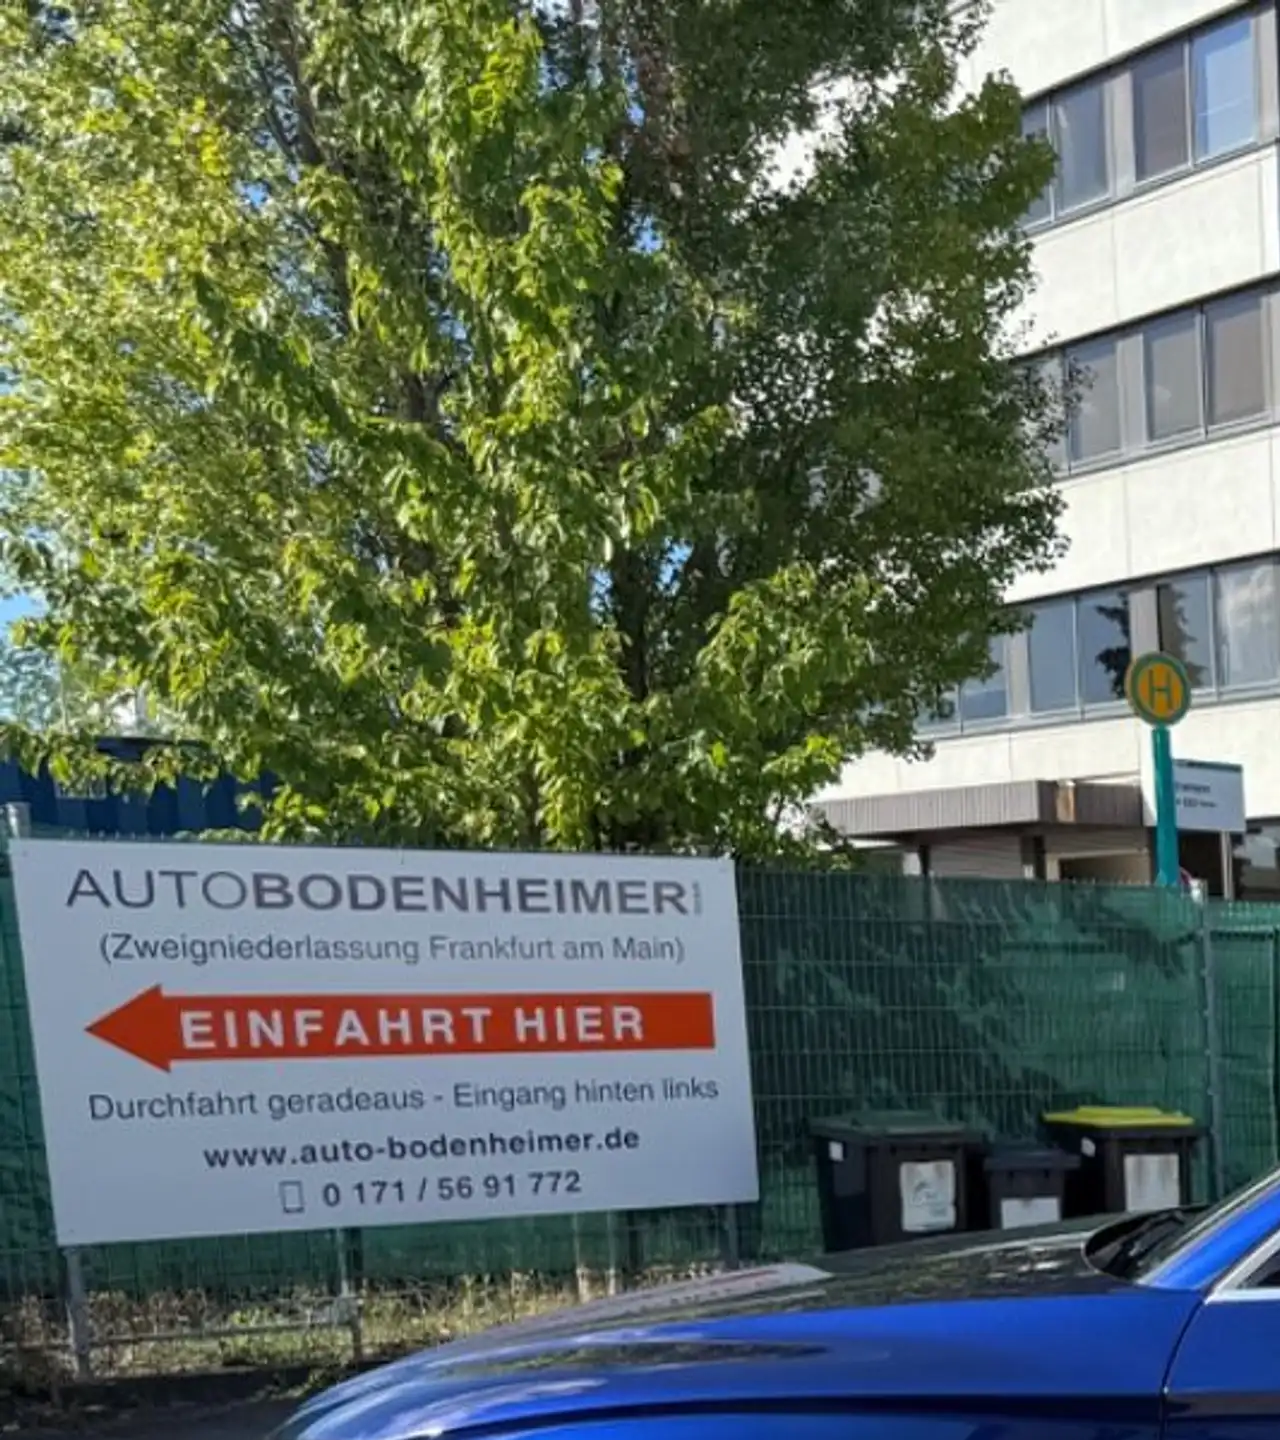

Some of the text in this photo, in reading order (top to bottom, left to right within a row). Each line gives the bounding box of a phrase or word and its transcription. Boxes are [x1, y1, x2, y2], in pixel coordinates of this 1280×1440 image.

[65, 868, 688, 915] AUTOBODENHEIMER
[99, 932, 686, 967] (Zweigniederlassung Frankfurt am Main)
[179, 1005, 644, 1050] EINFAHRT HIER
[88, 1090, 260, 1122] Durchfahrt
[267, 1088, 427, 1118] geradeaus
[452, 1081, 567, 1112] Eingang
[574, 1080, 653, 1105] hinten
[661, 1075, 720, 1102] links
[203, 1127, 641, 1169] www.auto-bodenheimer.de
[321, 1182, 342, 1208] 0
[352, 1179, 405, 1205] 171
[437, 1176, 474, 1201] 56
[482, 1173, 516, 1199] 91
[527, 1169, 583, 1195] 772
